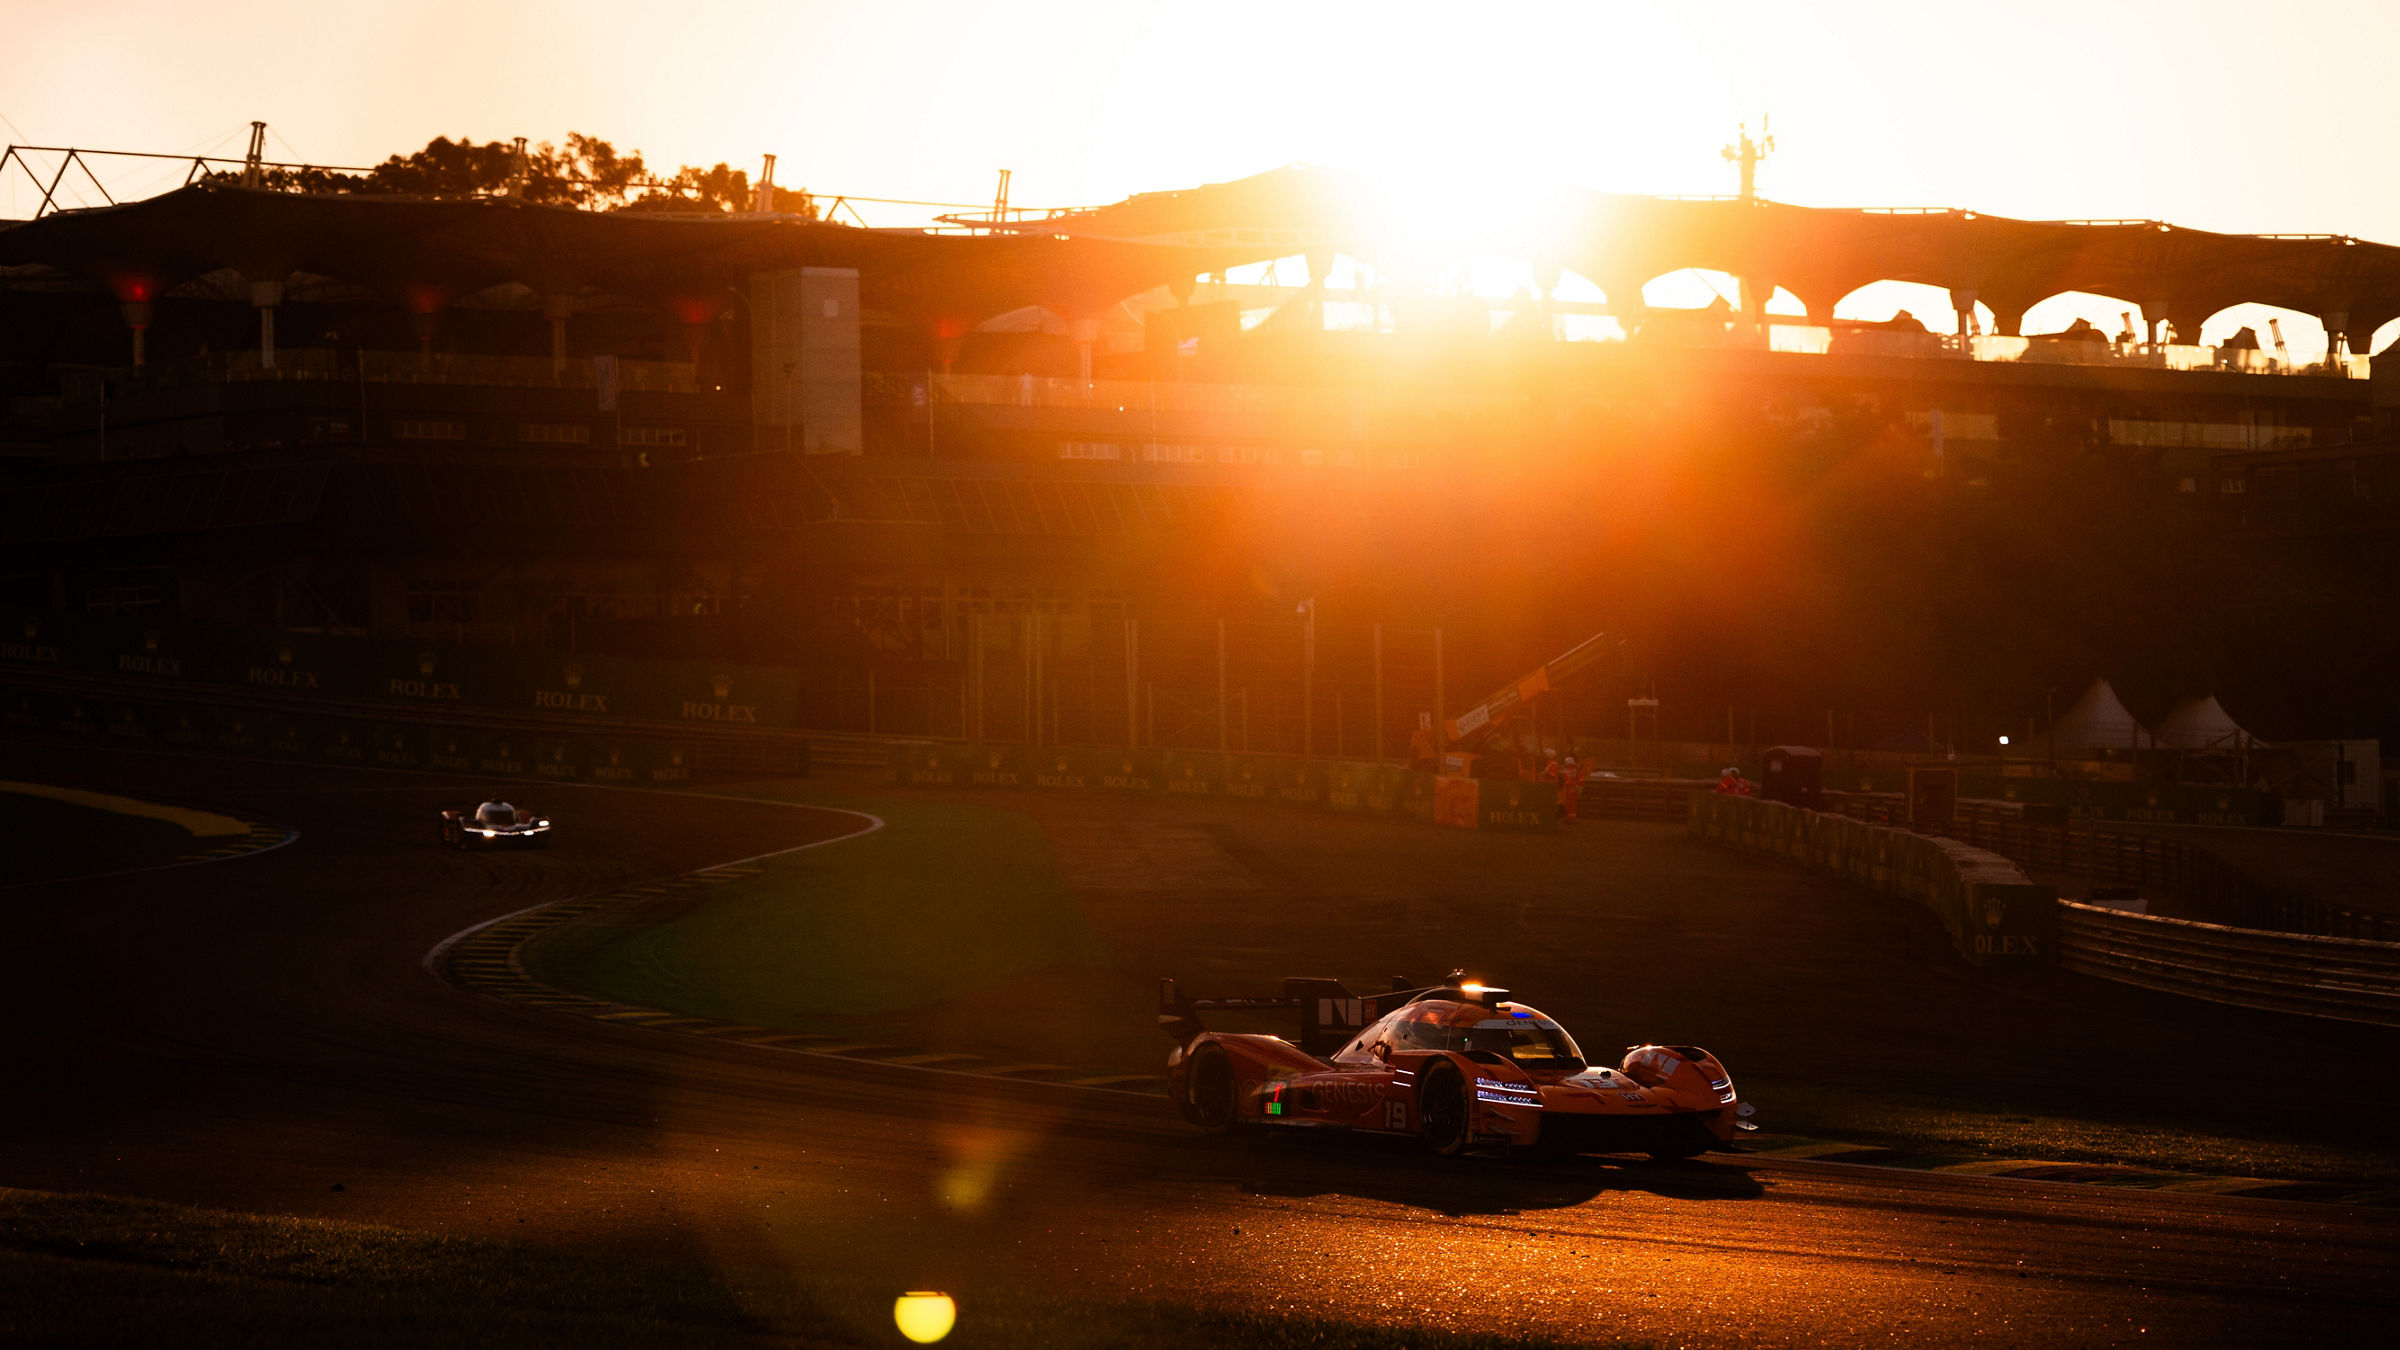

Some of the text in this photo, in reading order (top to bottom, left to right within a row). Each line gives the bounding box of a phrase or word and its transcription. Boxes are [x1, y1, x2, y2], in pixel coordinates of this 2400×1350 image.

[1, 643, 59, 665] ROLEX
[119, 654, 184, 677] ROLEX
[249, 667, 320, 689] ROLEX
[389, 679, 462, 699] ROLEX
[536, 690, 607, 712] ROLEX
[682, 702, 758, 722] ROLEX
[653, 769, 688, 781] ROLE
[913, 770, 951, 783] ROLEX
[972, 772, 1018, 785] ROLEX
[1037, 774, 1085, 788] ROLEX
[1103, 776, 1149, 790] ROLEX
[1490, 811, 1539, 824] ROLEX
[2127, 808, 2175, 821] ROLEX
[2198, 811, 2246, 825] ROLEX
[1975, 934, 2039, 955] OLEX
[1312, 1081, 1385, 1103] GENESIS
[1385, 1101, 1406, 1128] 19
